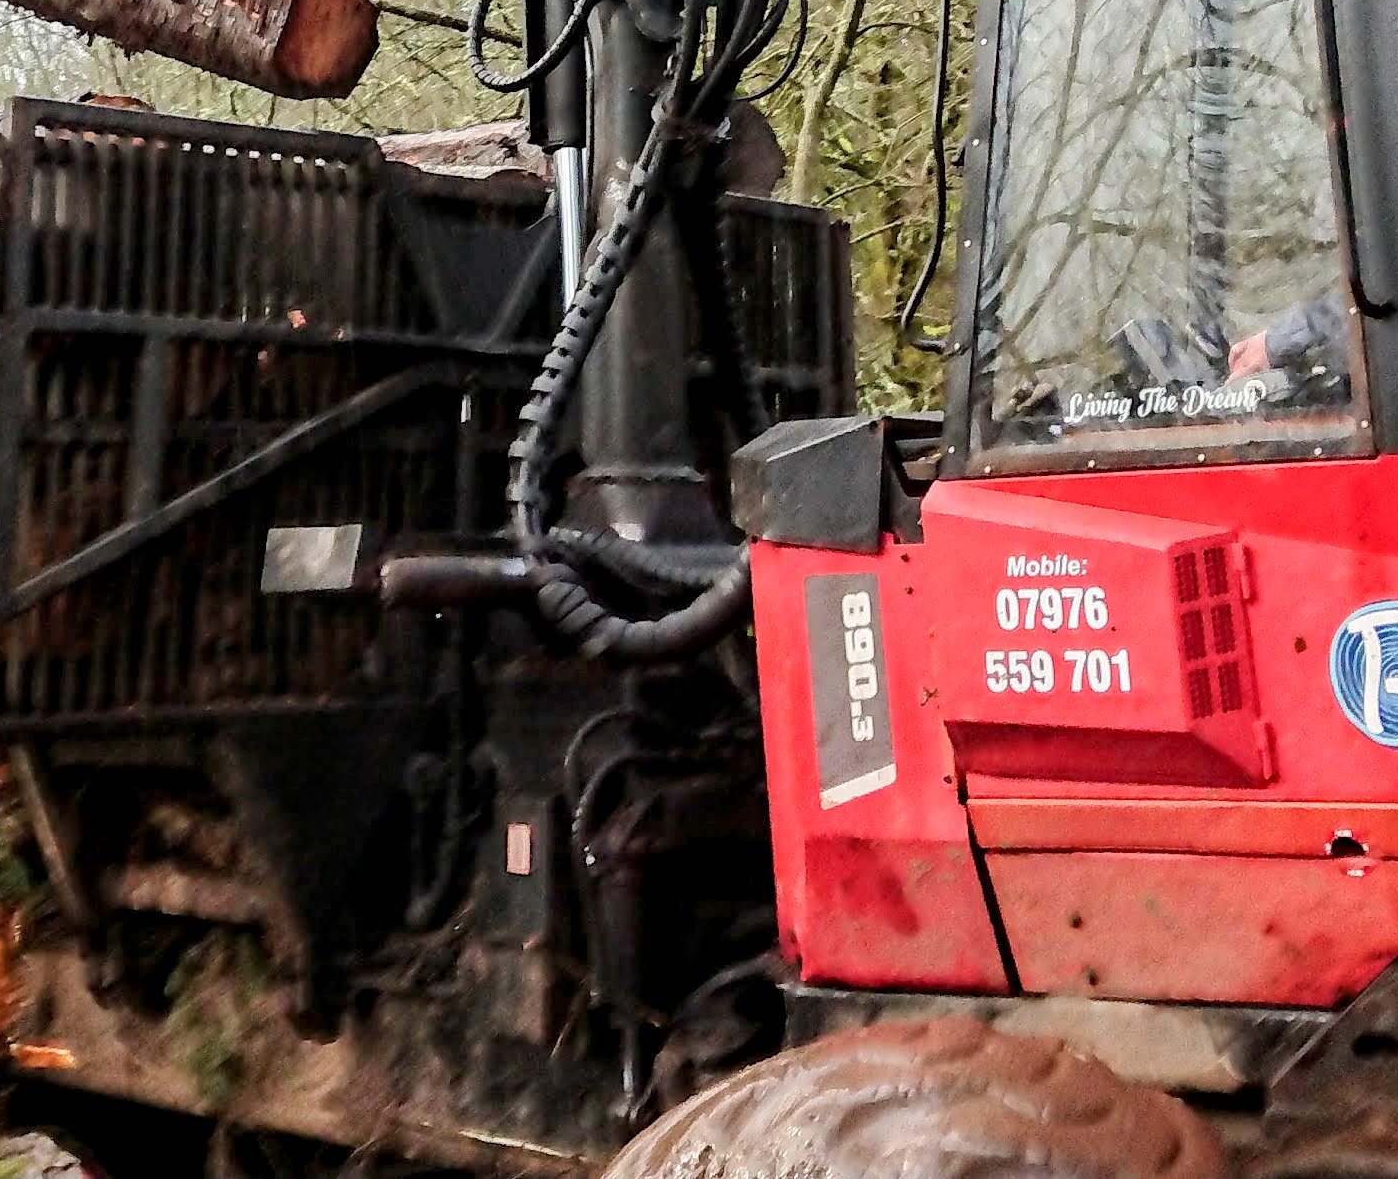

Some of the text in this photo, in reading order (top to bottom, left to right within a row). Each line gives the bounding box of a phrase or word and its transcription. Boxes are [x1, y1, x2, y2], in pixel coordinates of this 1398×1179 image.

[1064, 379, 1266, 423] Living The Dream
[1006, 554, 1089, 577] Mobile:
[996, 587, 1108, 631] 07976
[984, 649, 1131, 693] 559 701
